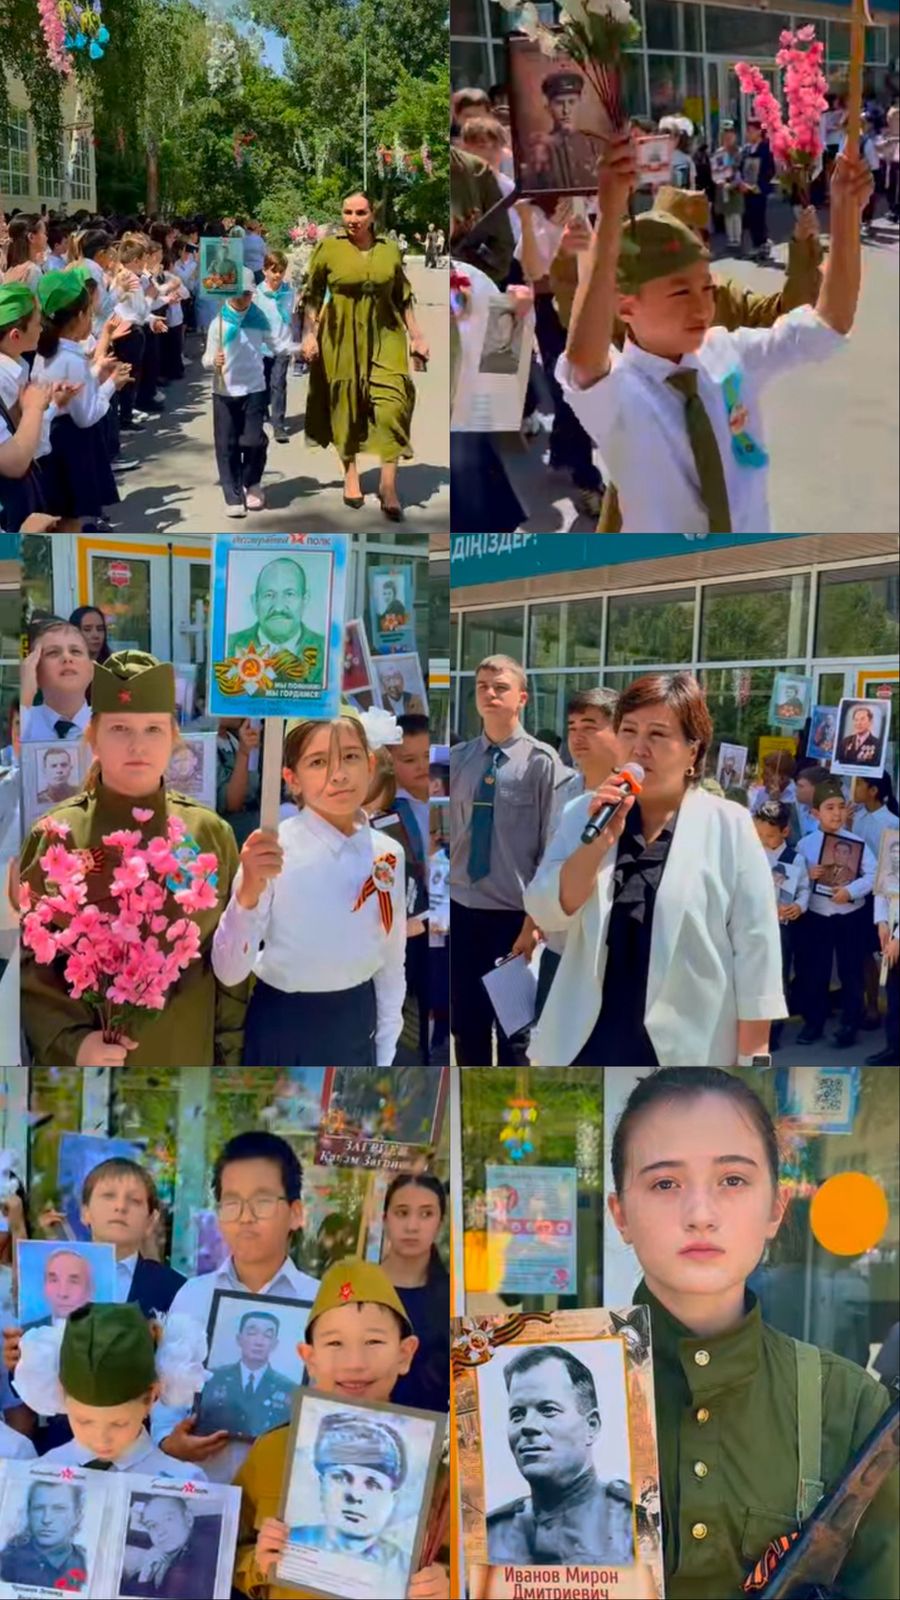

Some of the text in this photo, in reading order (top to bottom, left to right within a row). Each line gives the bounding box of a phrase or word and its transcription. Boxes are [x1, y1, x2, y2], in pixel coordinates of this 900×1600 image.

[505, 1566, 618, 1587] Иванов Мирон
[513, 1583, 609, 1600] Дмитриевич
